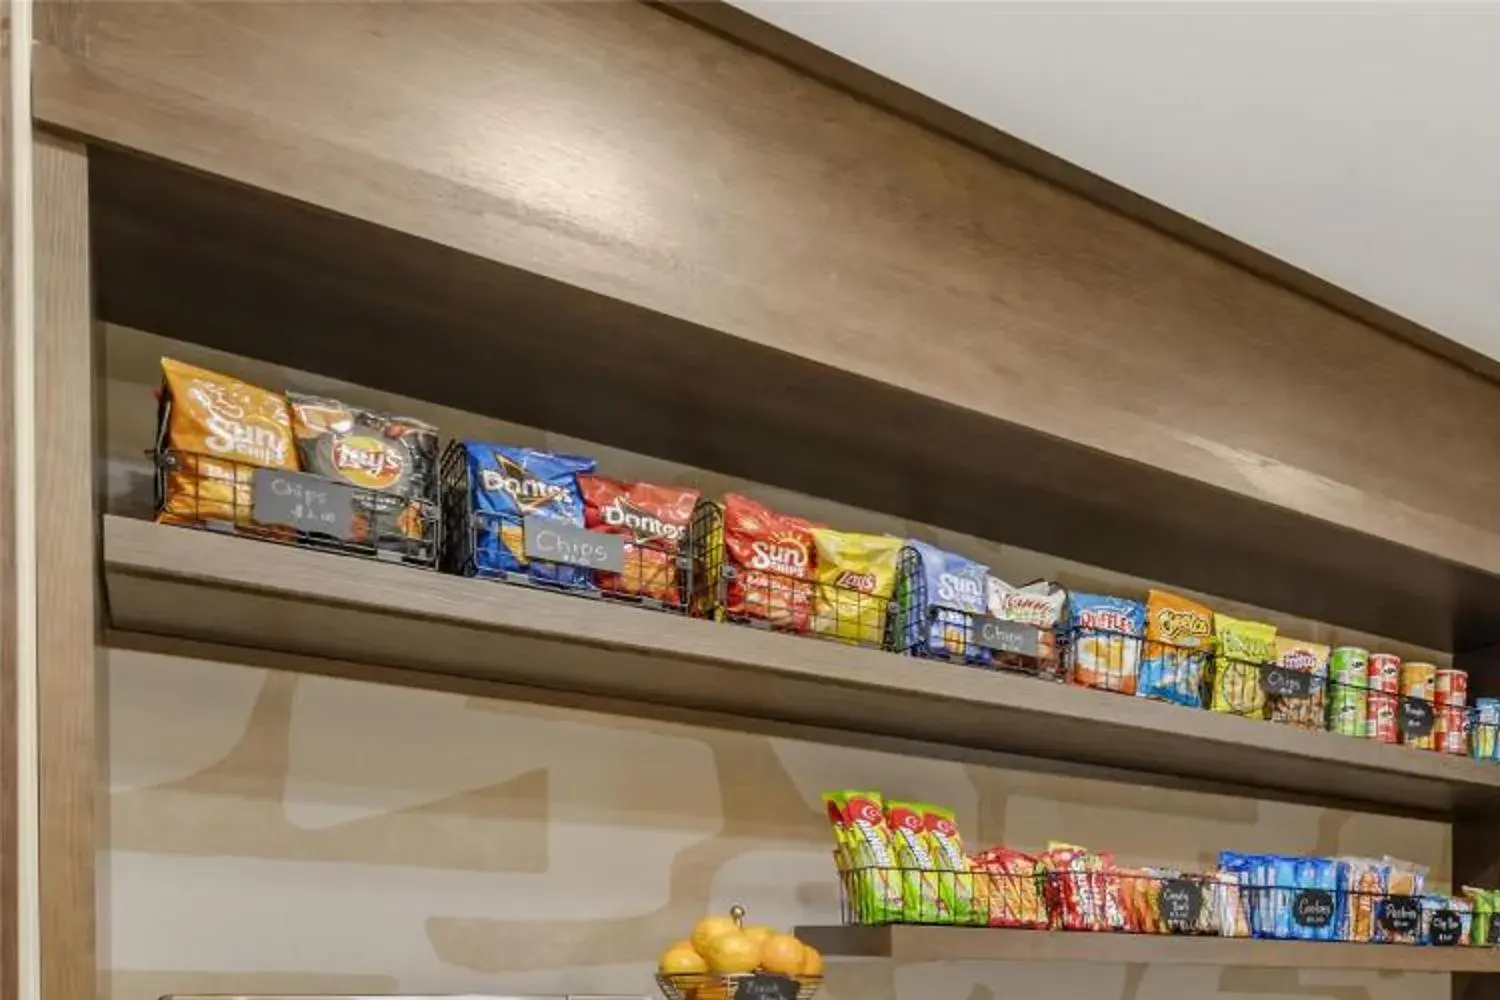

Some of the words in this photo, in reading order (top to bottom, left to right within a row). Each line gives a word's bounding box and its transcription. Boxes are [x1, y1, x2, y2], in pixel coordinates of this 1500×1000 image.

[480, 469, 574, 504] Doritos
[603, 500, 687, 542] Doritos
[536, 529, 608, 563] Chips
[751, 540, 805, 569] Sun
[938, 573, 983, 601] Sun
